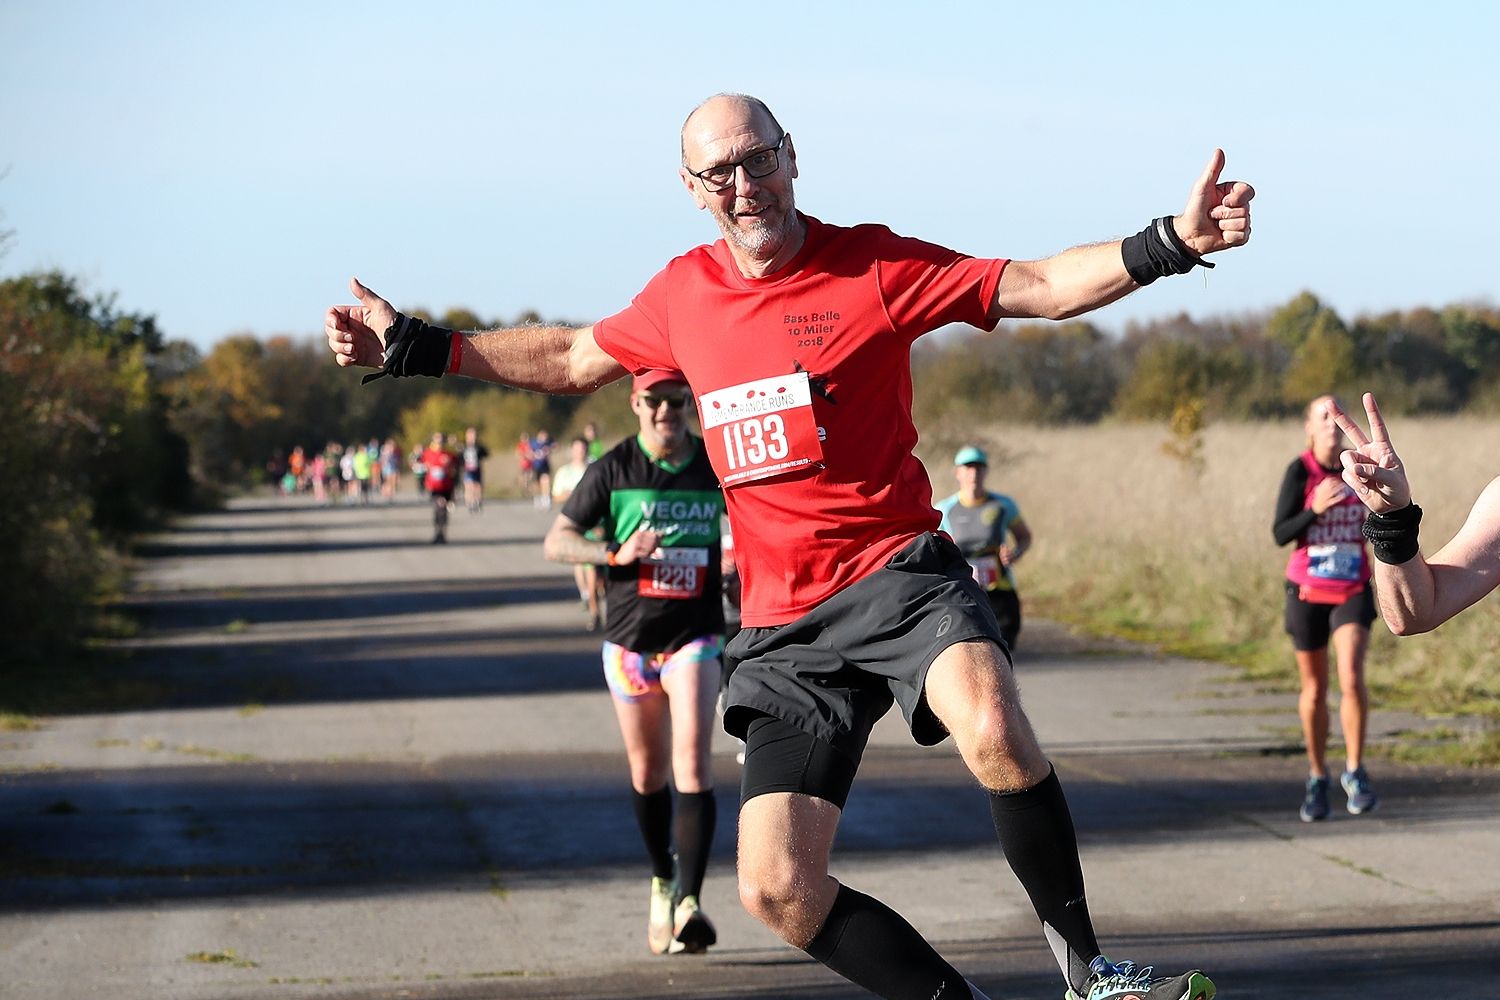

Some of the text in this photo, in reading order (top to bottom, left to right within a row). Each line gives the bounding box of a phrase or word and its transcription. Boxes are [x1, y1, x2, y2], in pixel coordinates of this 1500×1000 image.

[783, 310, 841, 324] Bass Belle
[788, 323, 835, 336] 10 Miler
[798, 336, 824, 347] 2018
[768, 393, 796, 408] RUNS
[722, 413, 790, 470] 1133
[639, 500, 717, 520] VEGAN
[652, 566, 697, 591] 1229
